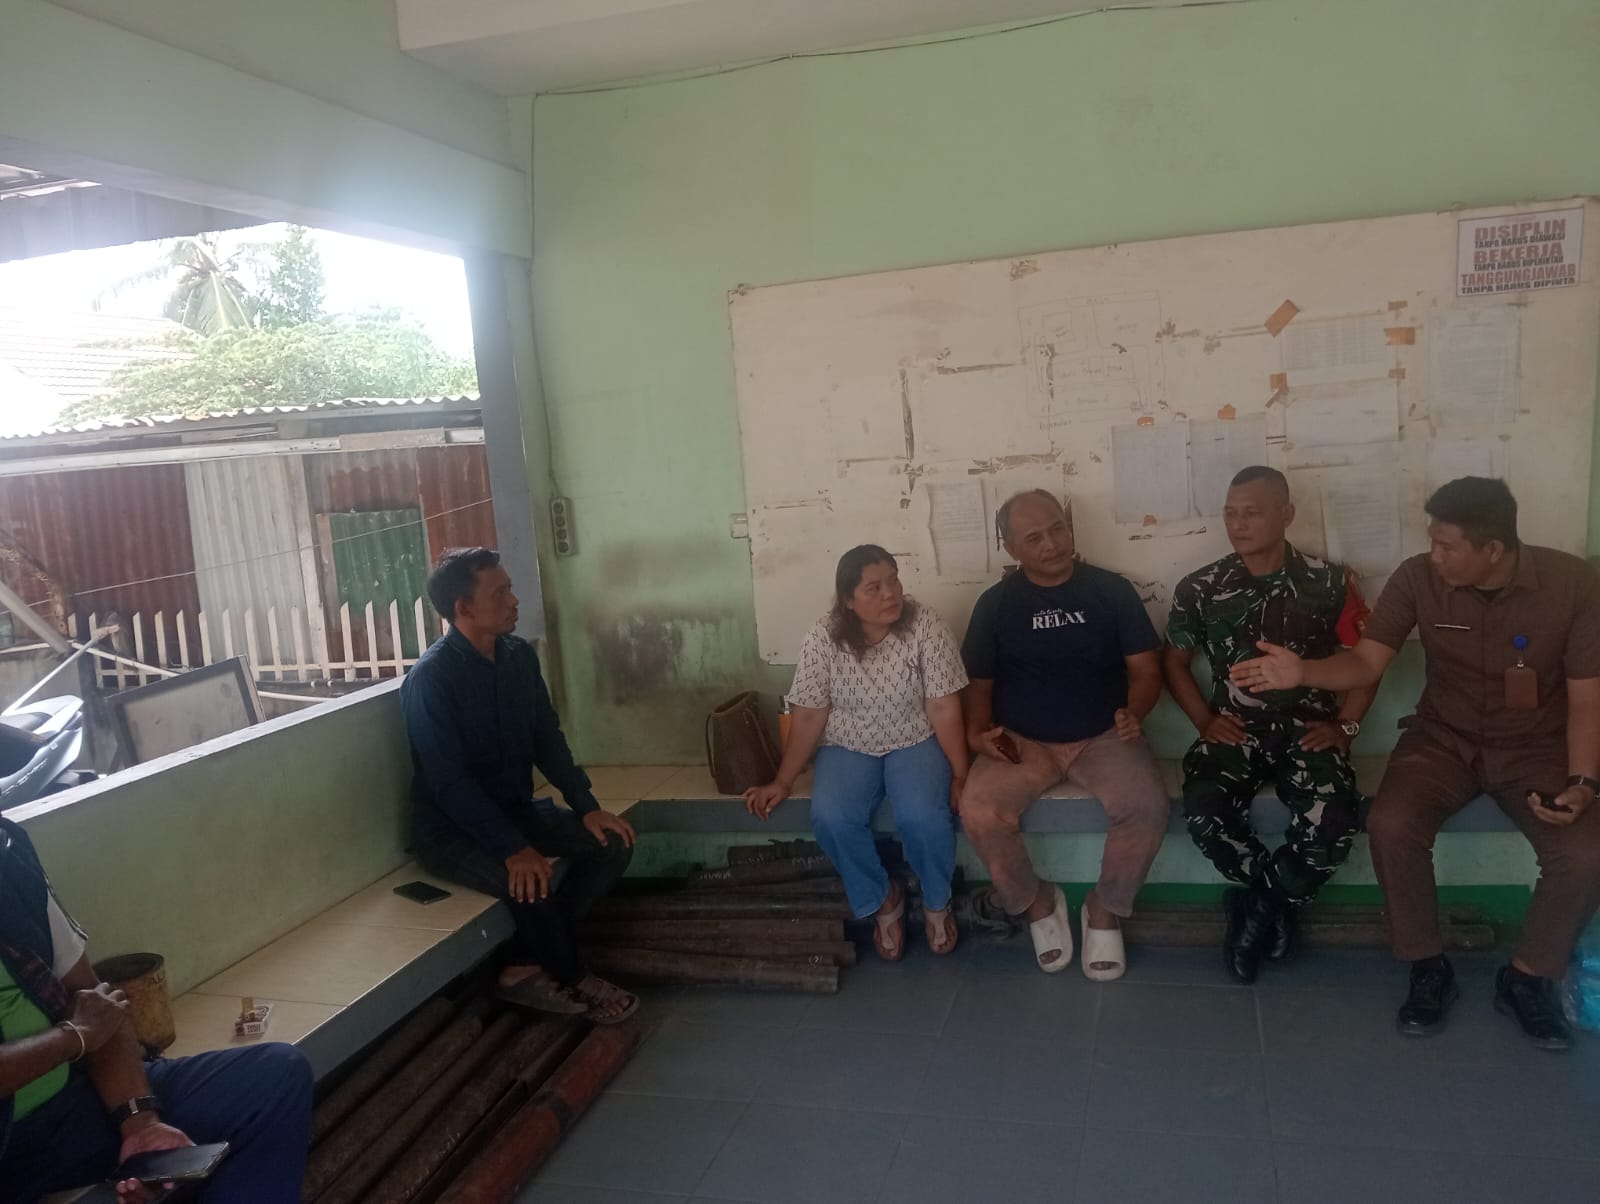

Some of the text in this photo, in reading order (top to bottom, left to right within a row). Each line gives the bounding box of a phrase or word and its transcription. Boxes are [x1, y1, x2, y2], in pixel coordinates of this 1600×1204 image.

[1475, 219, 1566, 240] DISIPLIN
[1474, 242, 1563, 264] BEKERJA
[1461, 264, 1576, 287] TANGGUNGJAWAB
[1461, 284, 1493, 294] TANPA
[1032, 611, 1085, 629] RELAX
